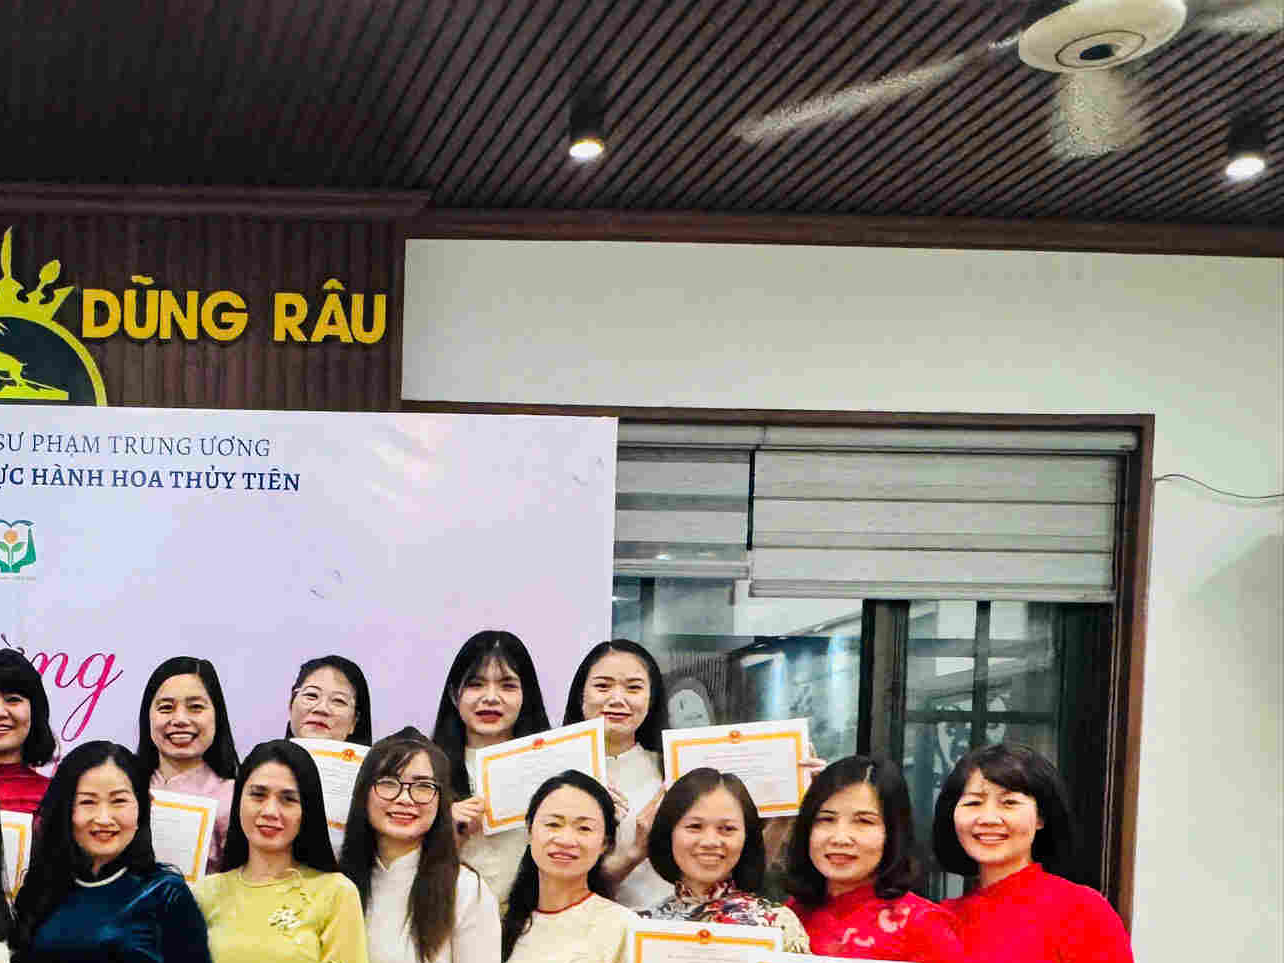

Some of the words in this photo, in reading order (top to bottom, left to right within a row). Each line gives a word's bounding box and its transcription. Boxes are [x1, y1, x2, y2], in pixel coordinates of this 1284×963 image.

[82, 274, 249, 341] DŨNG
[273, 278, 387, 343] RÂU
[32, 434, 101, 458] PHẠM
[107, 435, 192, 456] TRUNG
[200, 434, 271, 457] ƯƠNG
[31, 463, 105, 487] HÀNH
[111, 470, 164, 488] HOA
[170, 465, 236, 490] THỦY
[243, 466, 301, 492] TIÊN
